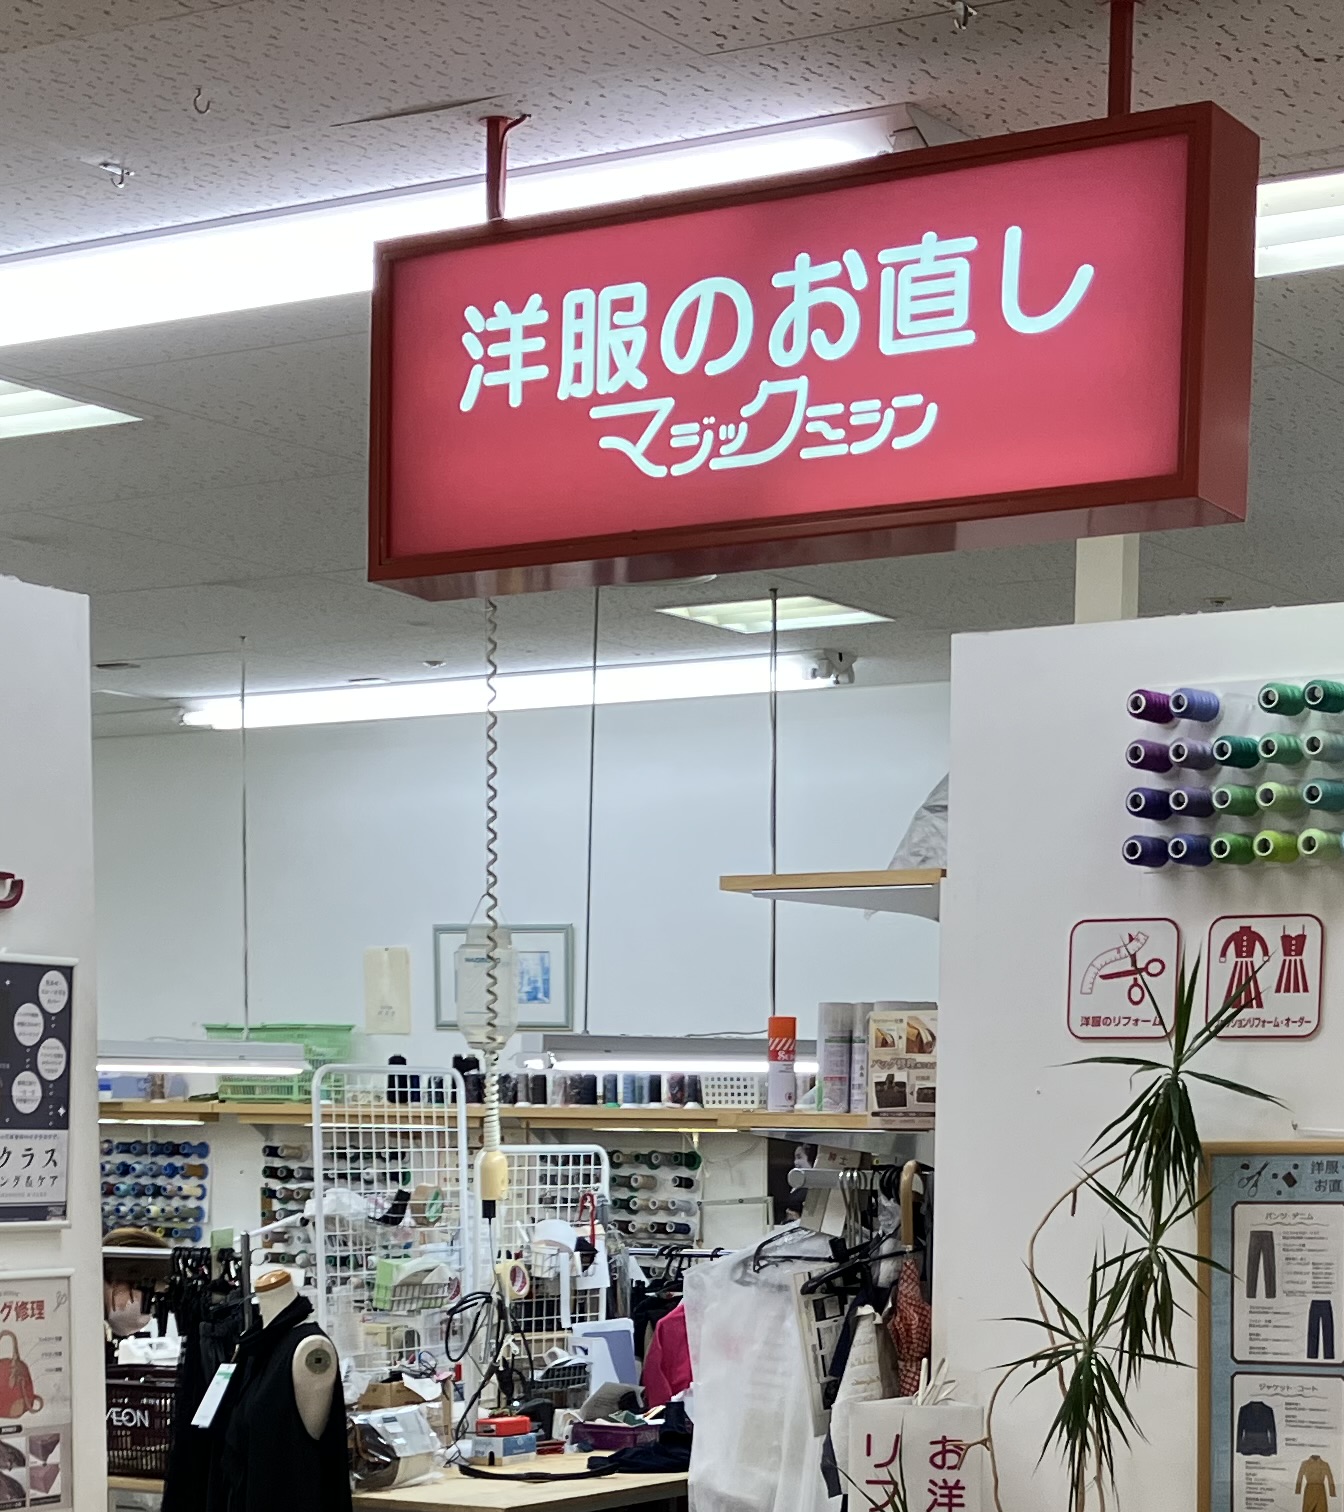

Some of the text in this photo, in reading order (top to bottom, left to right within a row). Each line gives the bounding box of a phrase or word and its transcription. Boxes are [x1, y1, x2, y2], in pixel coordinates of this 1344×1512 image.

[459, 225, 1095, 412] 洋服のお直し
[589, 375, 938, 477] マジックミシン
[1080, 1015, 1163, 1028] 洋服のリフォーム
